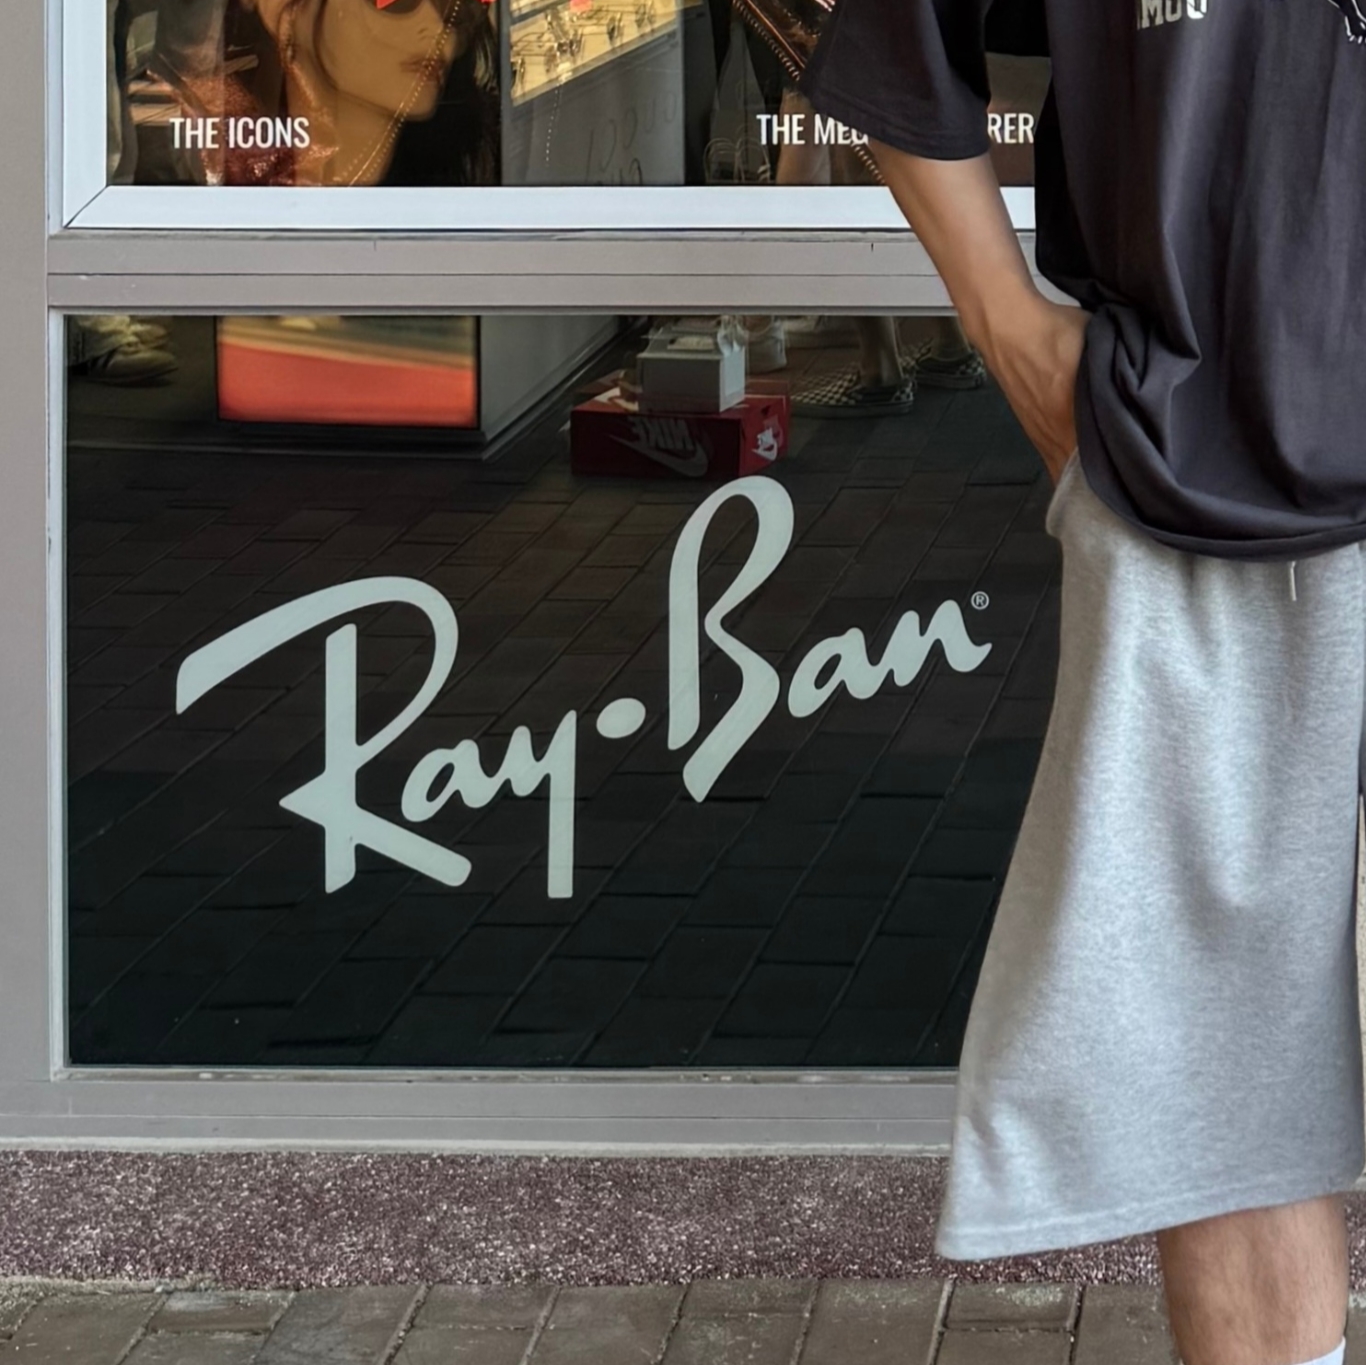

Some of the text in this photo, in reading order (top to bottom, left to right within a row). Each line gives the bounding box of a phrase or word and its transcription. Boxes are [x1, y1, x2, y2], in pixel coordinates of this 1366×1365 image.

[169, 116, 310, 149] THE ICONS
[756, 114, 805, 145] THE
